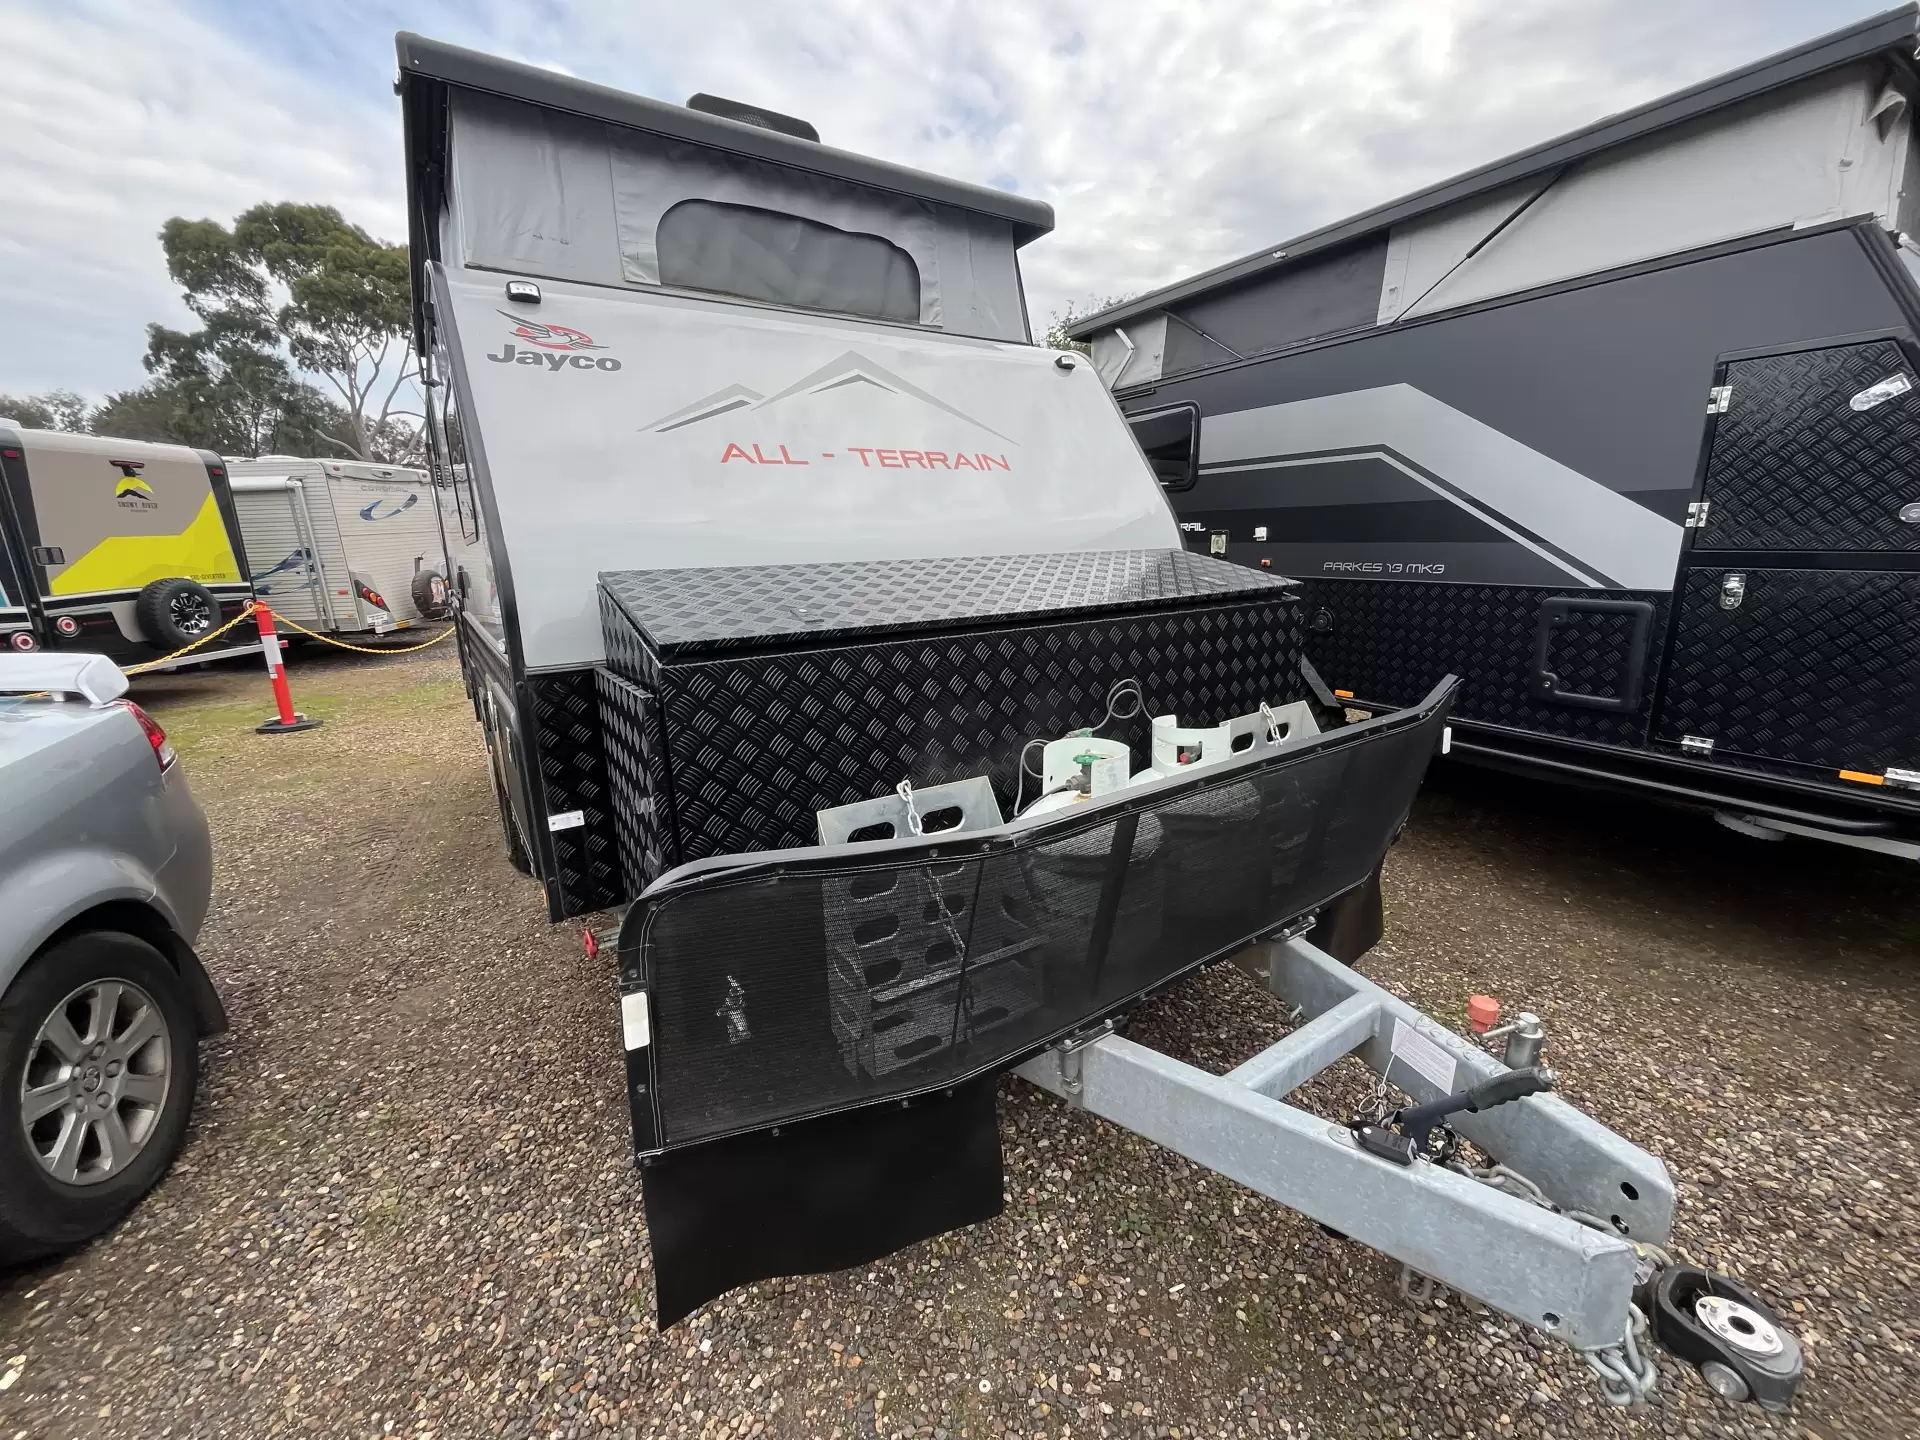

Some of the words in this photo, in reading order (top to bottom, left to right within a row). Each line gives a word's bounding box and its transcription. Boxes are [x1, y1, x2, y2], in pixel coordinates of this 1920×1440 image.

[487, 344, 621, 371] Jayco
[720, 443, 809, 465] ALL
[847, 447, 1011, 471] TERRAIN
[1323, 561, 1383, 572] PARKES
[1386, 563, 1402, 573] 13
[1406, 563, 1445, 574] MK3
